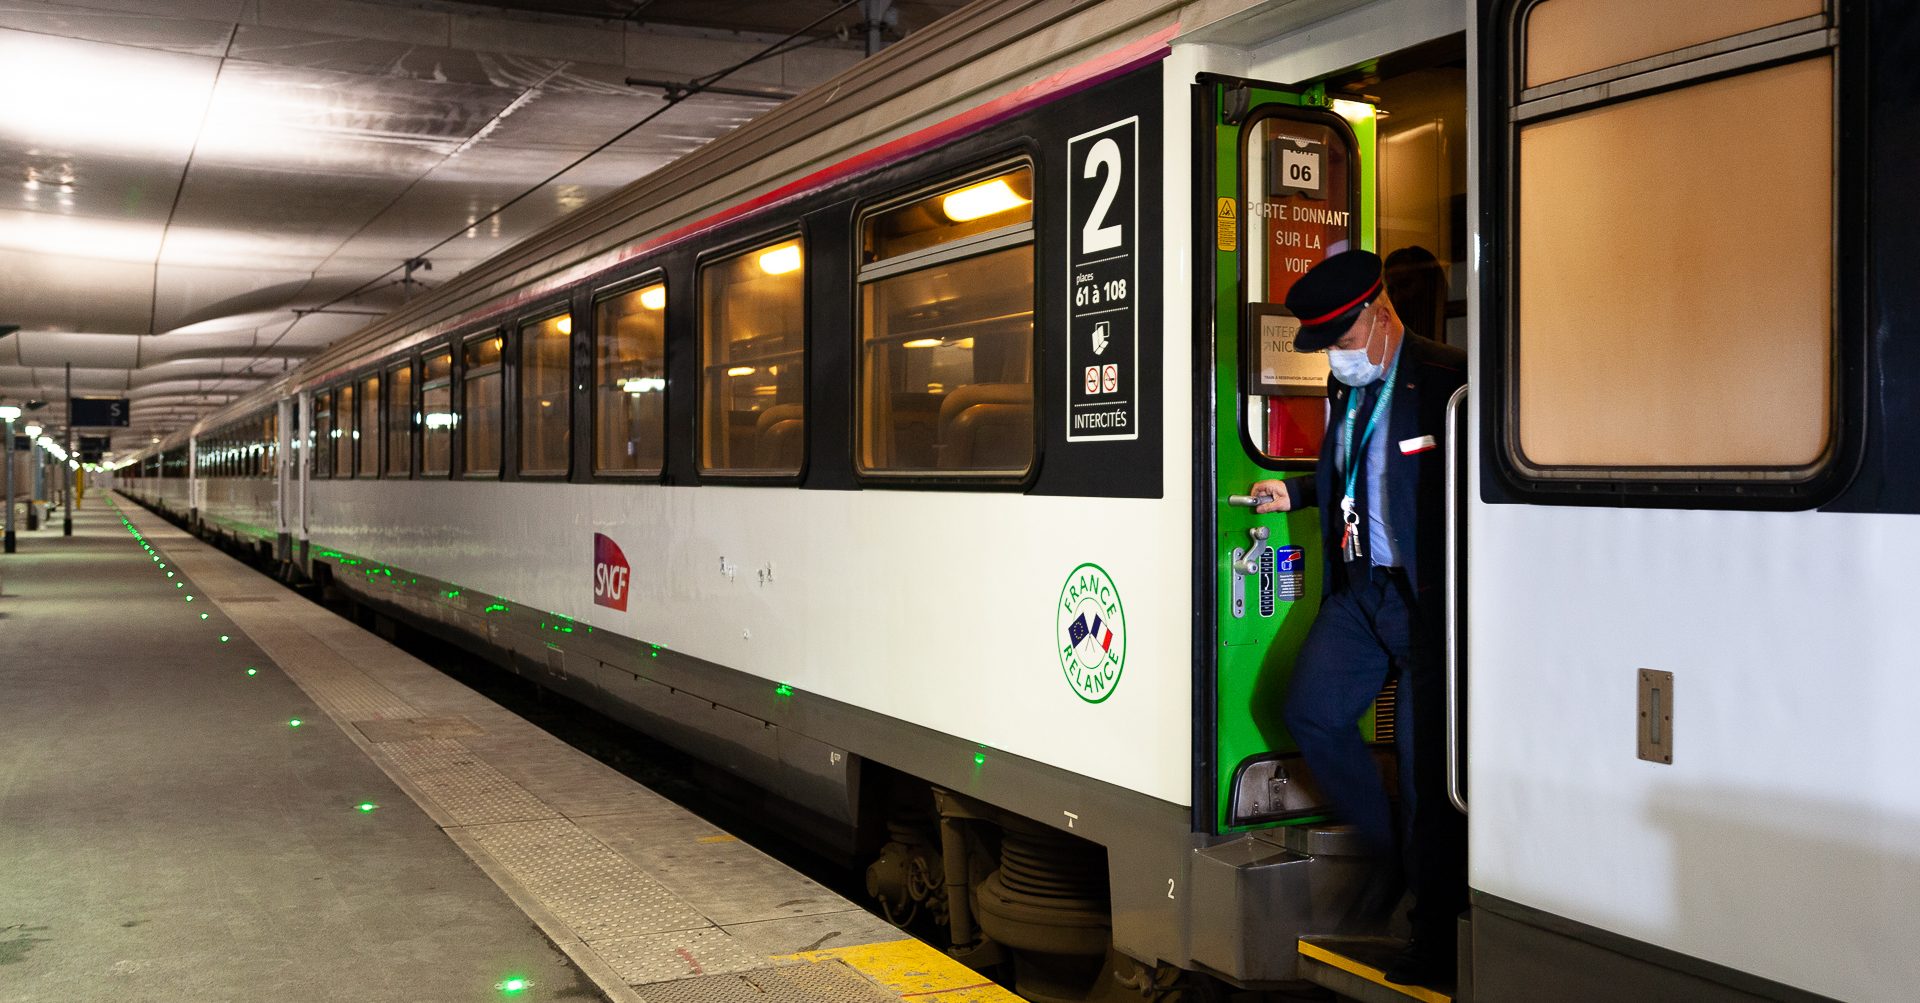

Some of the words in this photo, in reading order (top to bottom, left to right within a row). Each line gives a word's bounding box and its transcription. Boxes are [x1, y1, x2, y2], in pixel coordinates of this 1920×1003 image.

[1290, 163, 1312, 182] 06
[1082, 137, 1122, 255] 2
[1248, 201, 1288, 220] PORTE
[1293, 206, 1350, 227] DONNANT
[1276, 230, 1301, 247] SUR
[1305, 233, 1321, 250] LA
[1285, 257, 1312, 274] VOIE
[1076, 271, 1094, 284] places
[1075, 286, 1089, 308] 61
[1091, 285, 1100, 304] à
[1104, 278, 1127, 301] 108
[1272, 340, 1297, 353] NIC
[110, 402, 121, 417] S
[1074, 408, 1127, 429] INTERCITÉS
[595, 562, 628, 600] SNCF
[1064, 574, 1117, 620] FRANCE
[1063, 644, 1119, 694] RELANCE
[1167, 878, 1175, 900] 2
